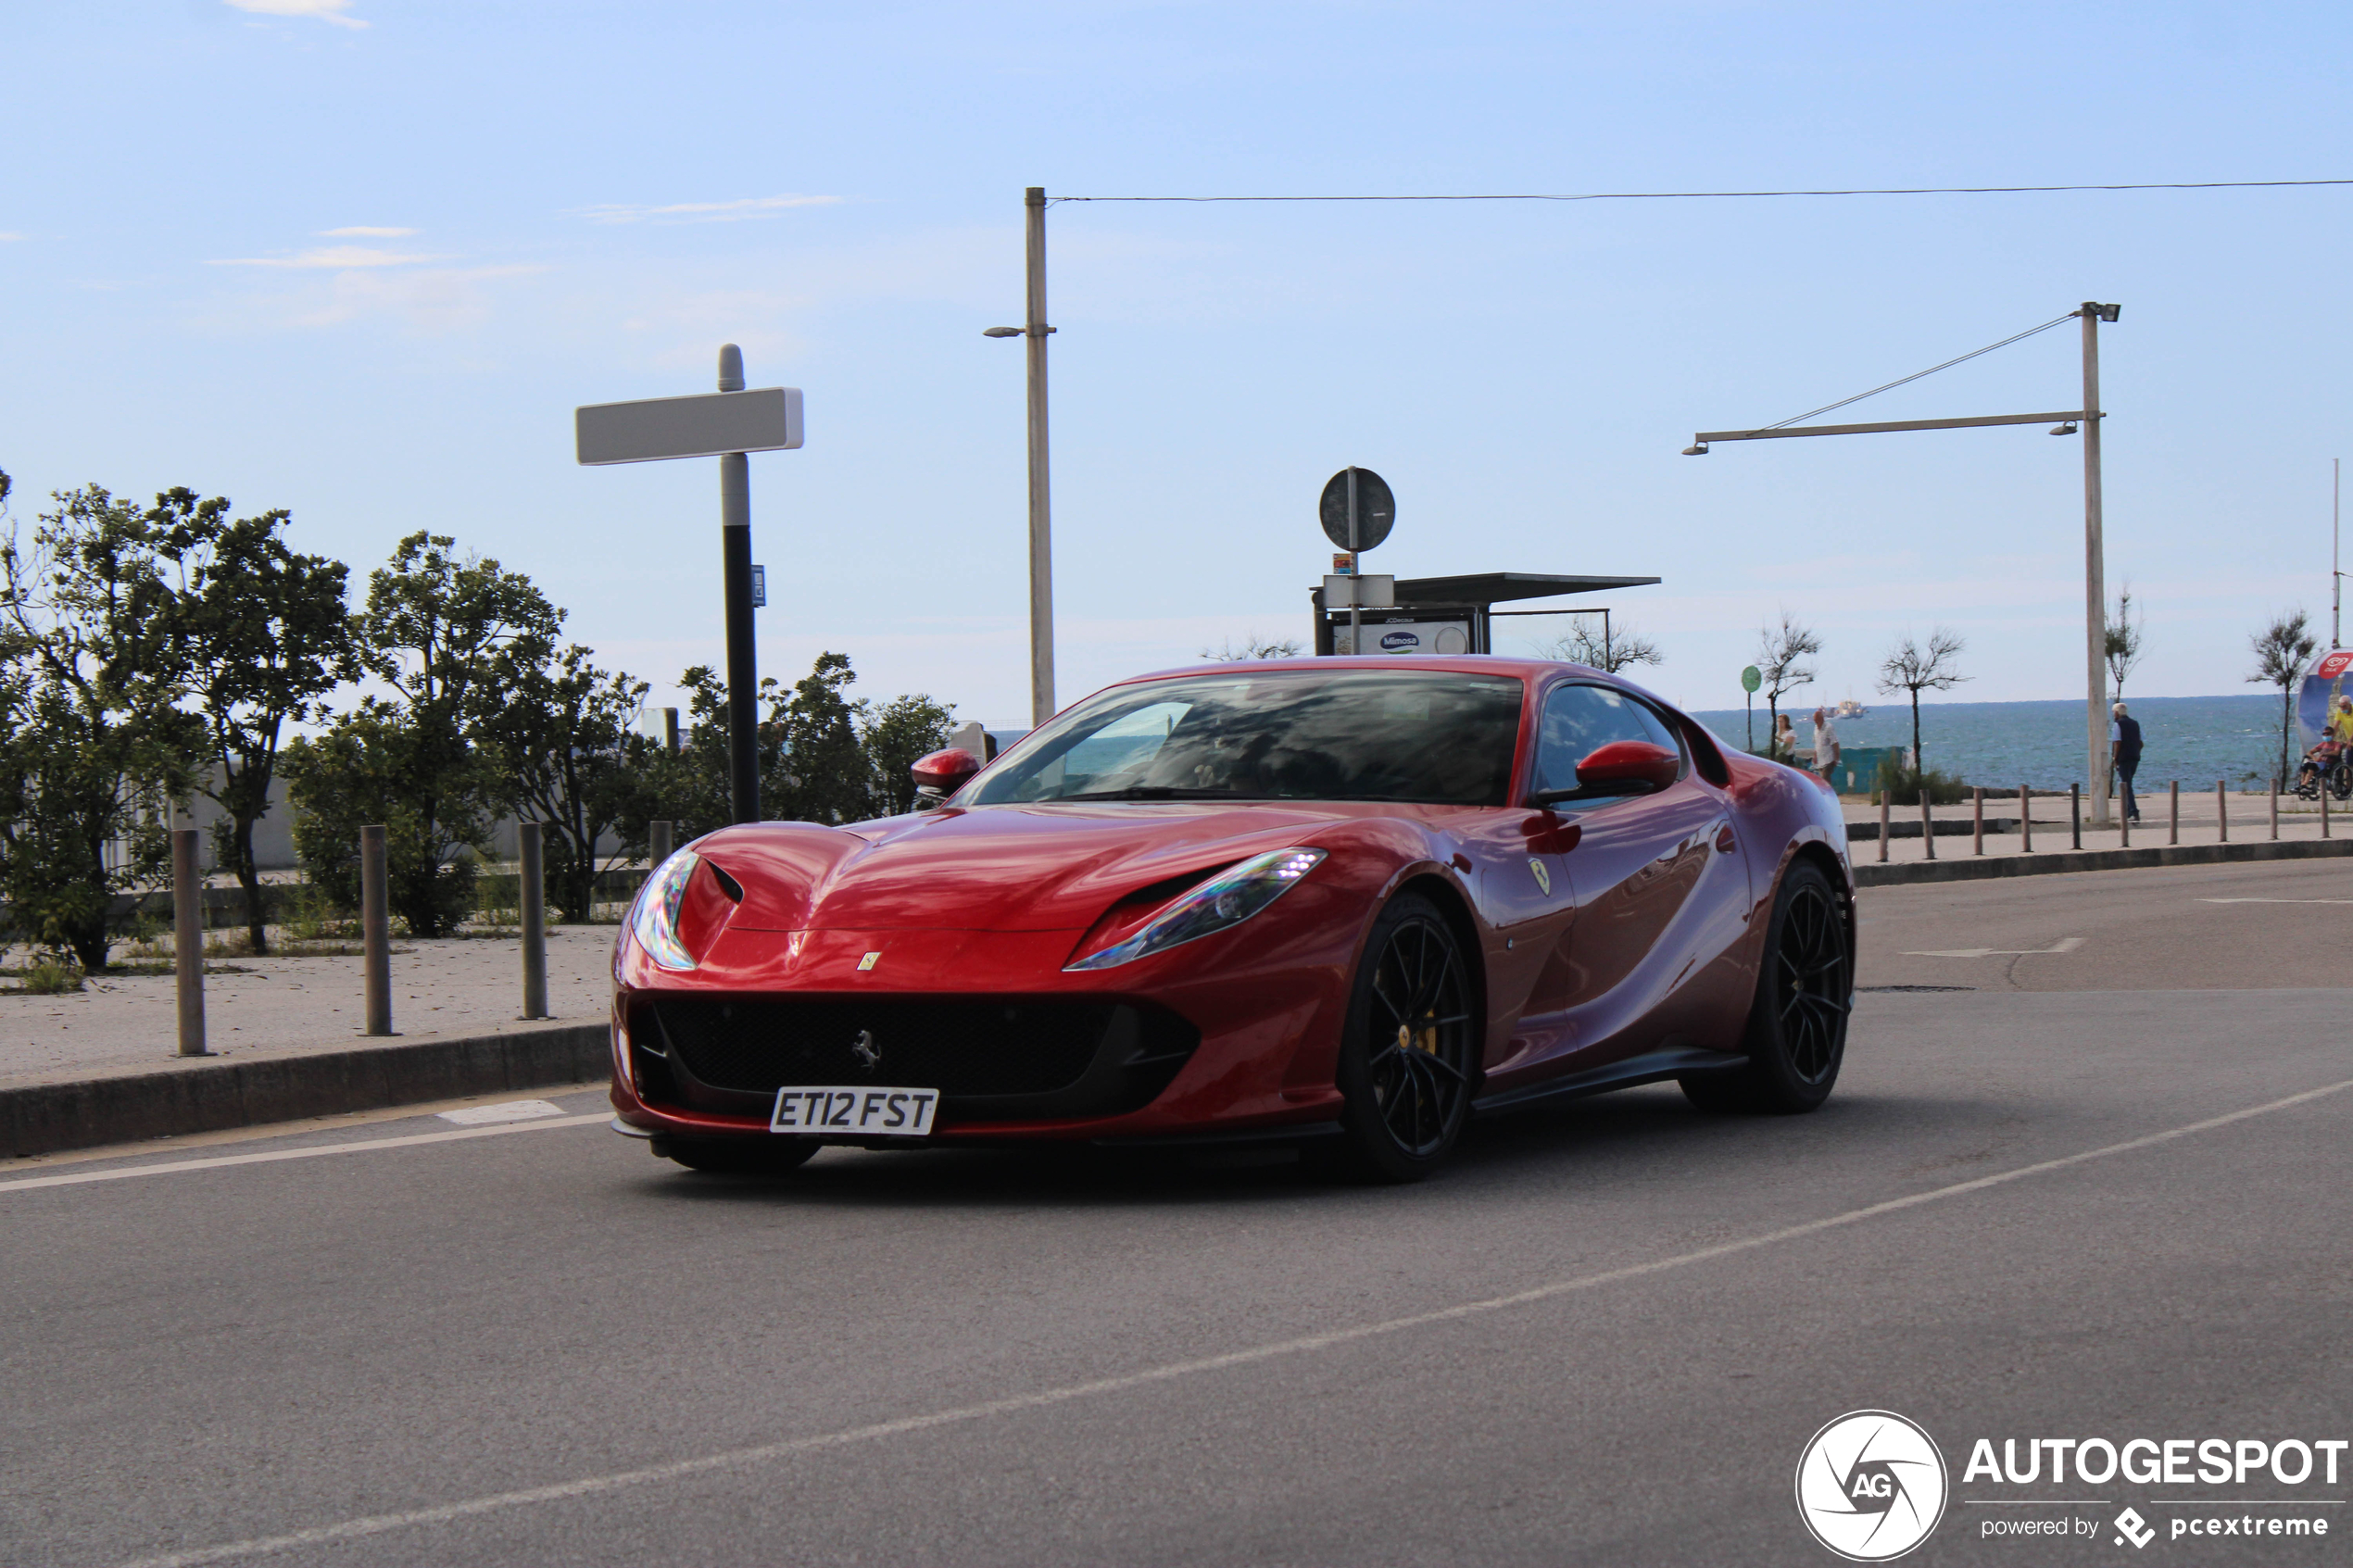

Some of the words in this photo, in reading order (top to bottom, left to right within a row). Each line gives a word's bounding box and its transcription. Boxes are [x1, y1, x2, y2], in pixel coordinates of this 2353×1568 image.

[1383, 636, 1417, 646] Mimosa
[775, 1092, 856, 1126] ET12
[859, 1093, 934, 1128] FST
